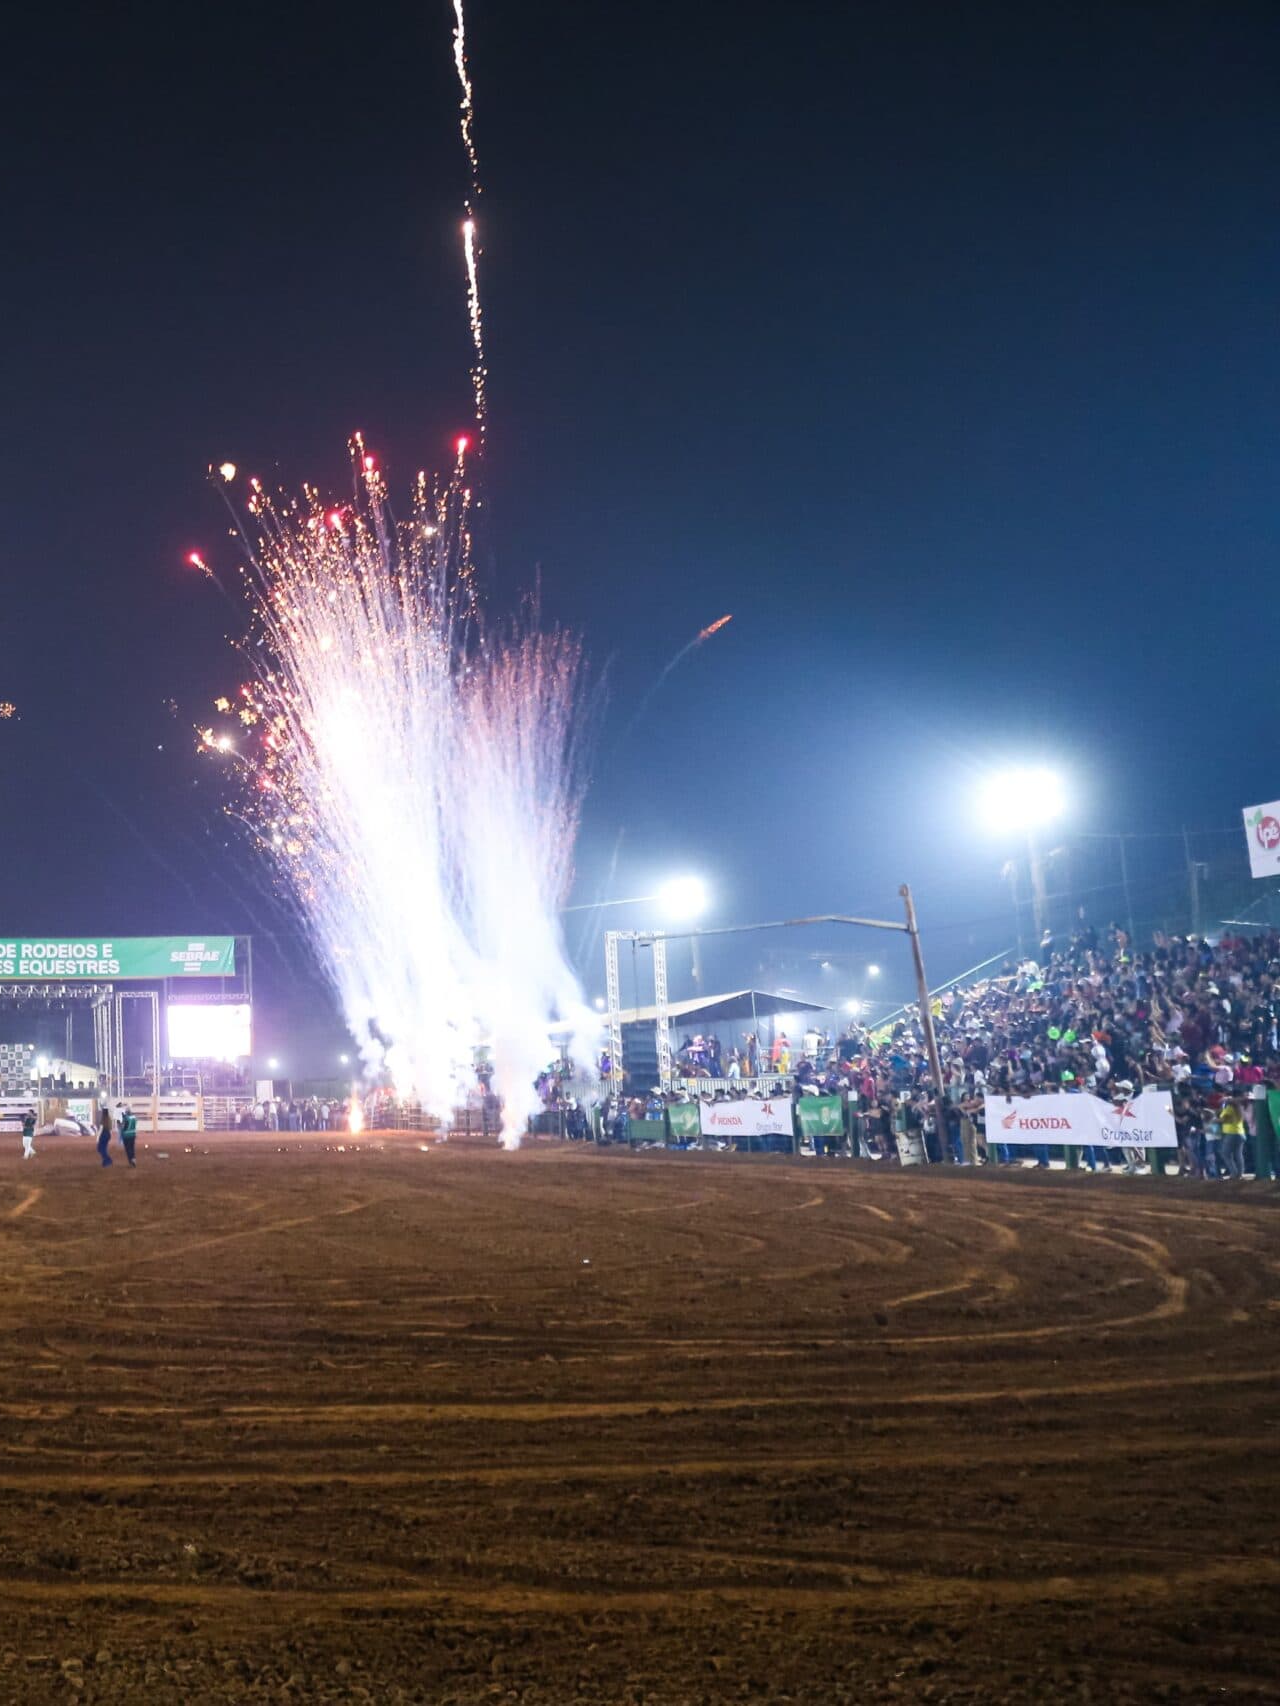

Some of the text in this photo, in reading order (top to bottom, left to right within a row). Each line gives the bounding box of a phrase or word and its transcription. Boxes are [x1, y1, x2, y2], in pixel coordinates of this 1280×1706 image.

[21, 943, 98, 959] RODEIOS
[102, 943, 113, 959] E
[170, 951, 220, 962] SEBRAE
[19, 960, 120, 976] EQUESTRES
[717, 1115, 743, 1126] HONDA
[1019, 1117, 1073, 1130] HONDA
[1132, 1128, 1153, 1142] Star
